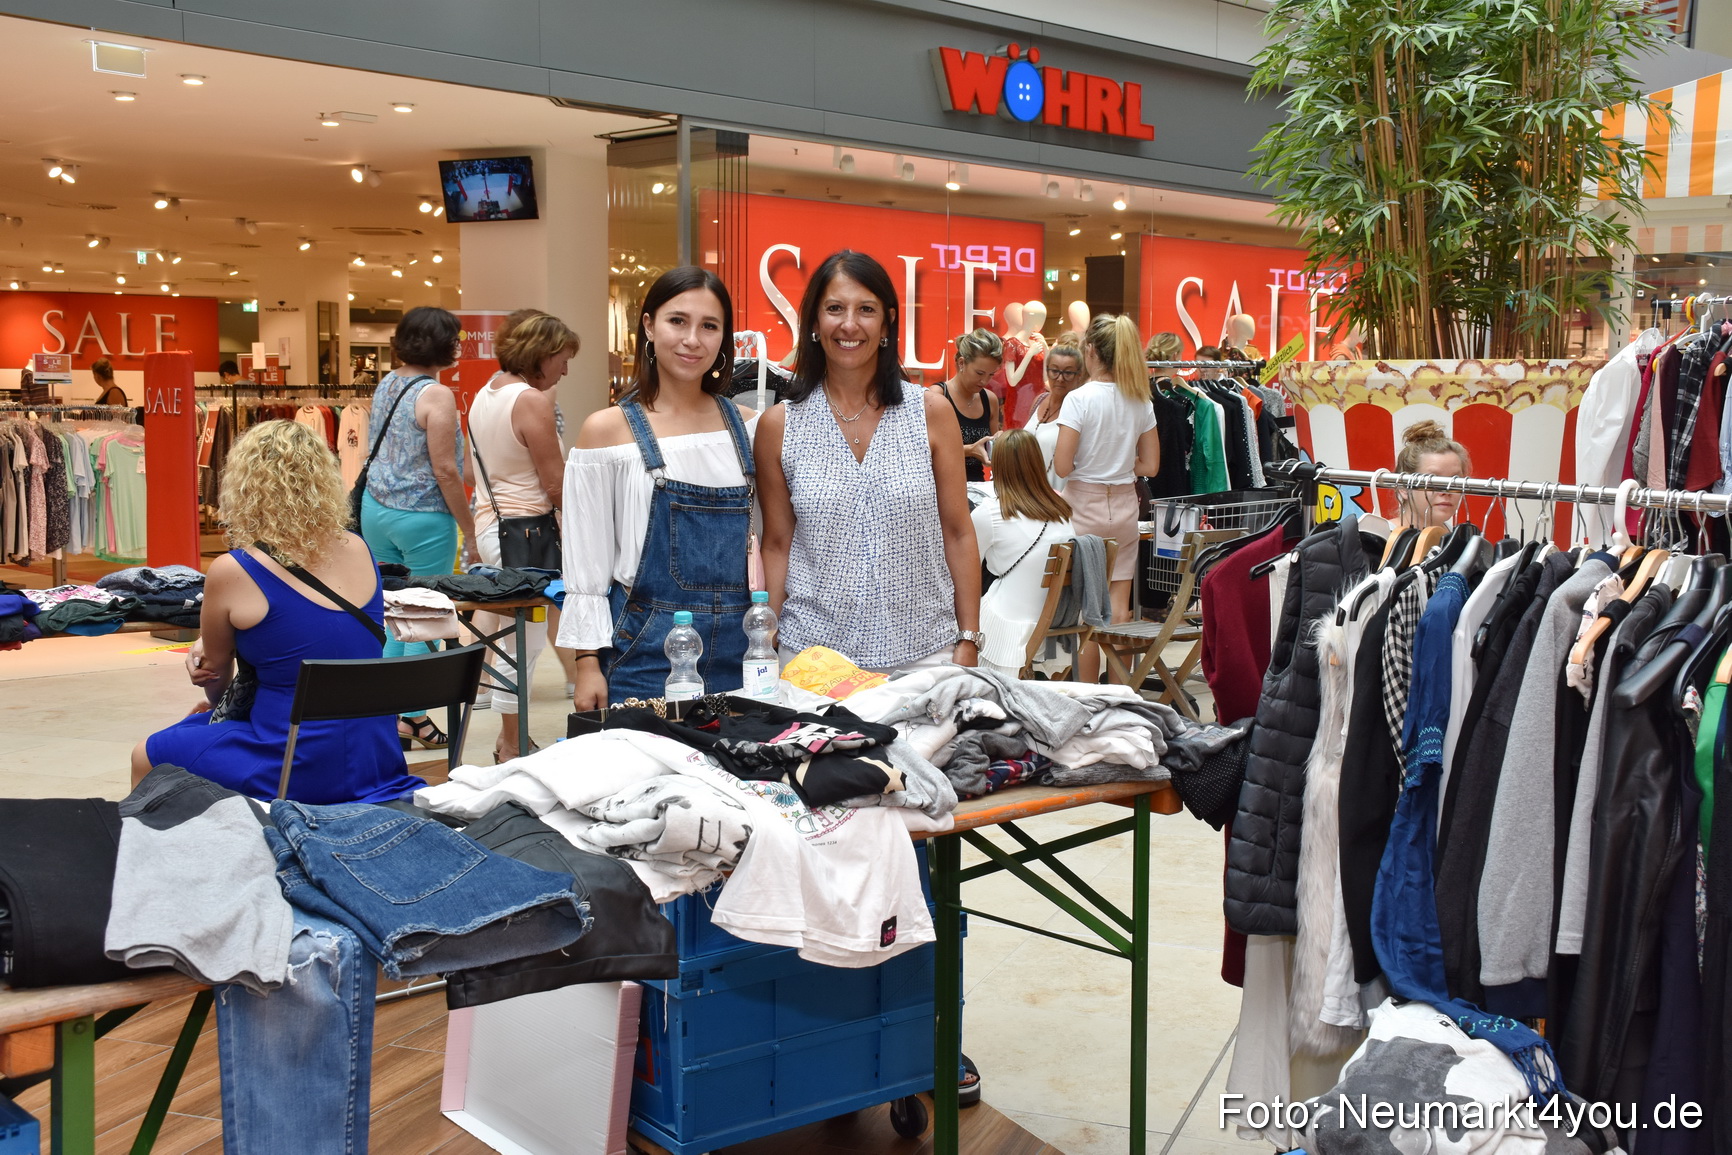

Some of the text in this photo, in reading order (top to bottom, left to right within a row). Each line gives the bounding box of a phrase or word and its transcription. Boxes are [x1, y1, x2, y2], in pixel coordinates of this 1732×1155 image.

[938, 42, 1154, 141] WÖHRL
[759, 243, 998, 370] SLE
[42, 309, 176, 357] SALE
[145, 387, 182, 415] SALE
[757, 665, 768, 677] ja!
